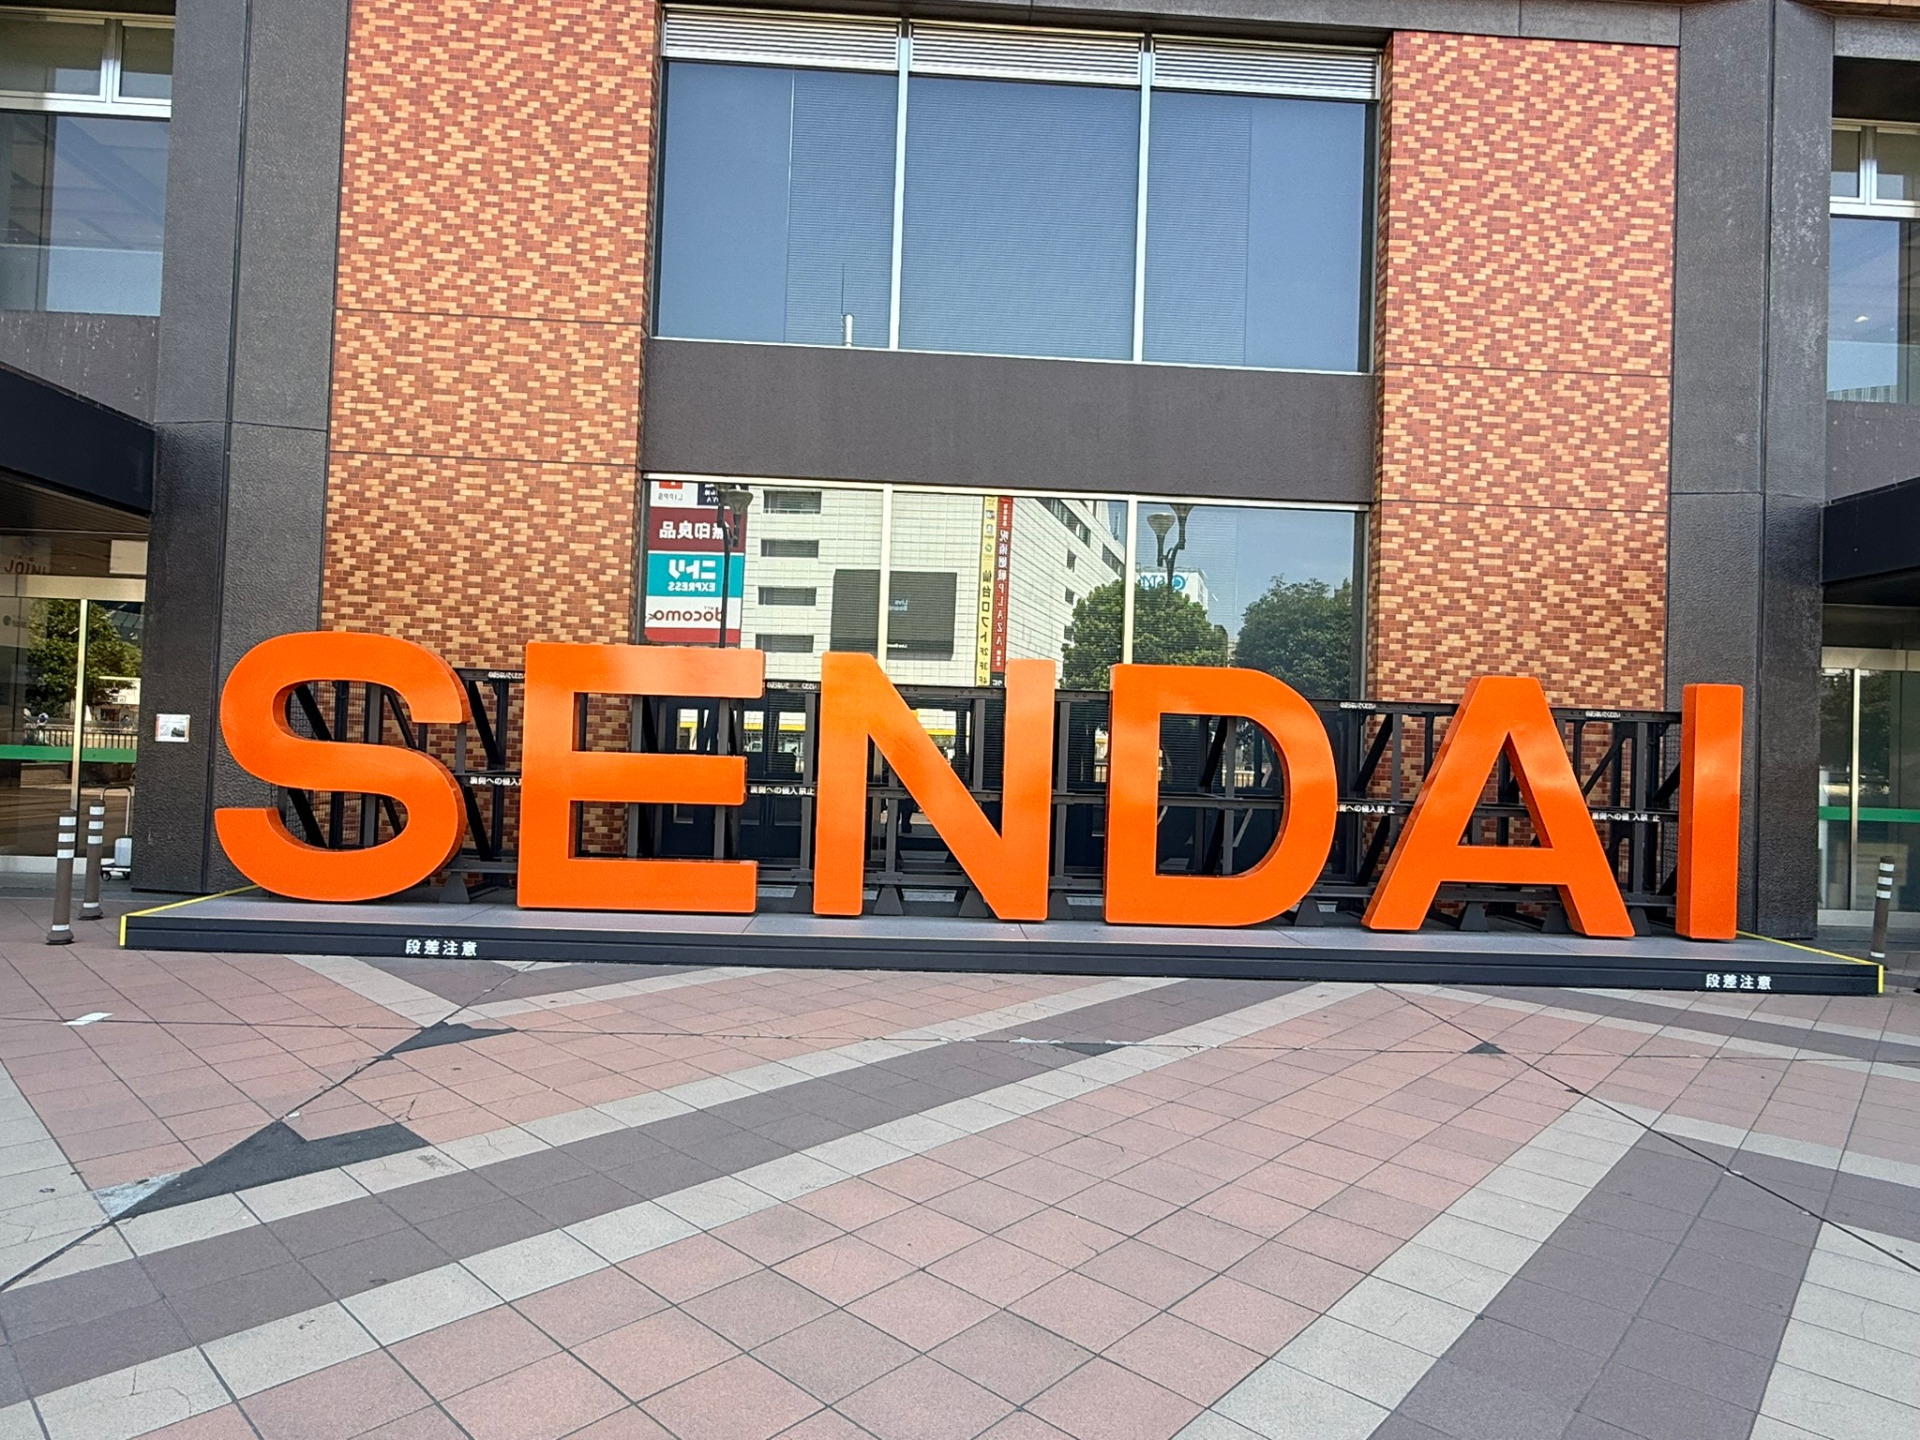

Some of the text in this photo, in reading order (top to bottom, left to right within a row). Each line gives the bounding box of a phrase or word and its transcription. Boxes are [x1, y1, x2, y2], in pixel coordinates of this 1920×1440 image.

[215, 630, 1744, 941] SENDAI
[1336, 804, 1396, 814] 側への侵入禁止
[405, 939, 478, 957] 段差注意
[1705, 973, 1772, 990] 段差注意
